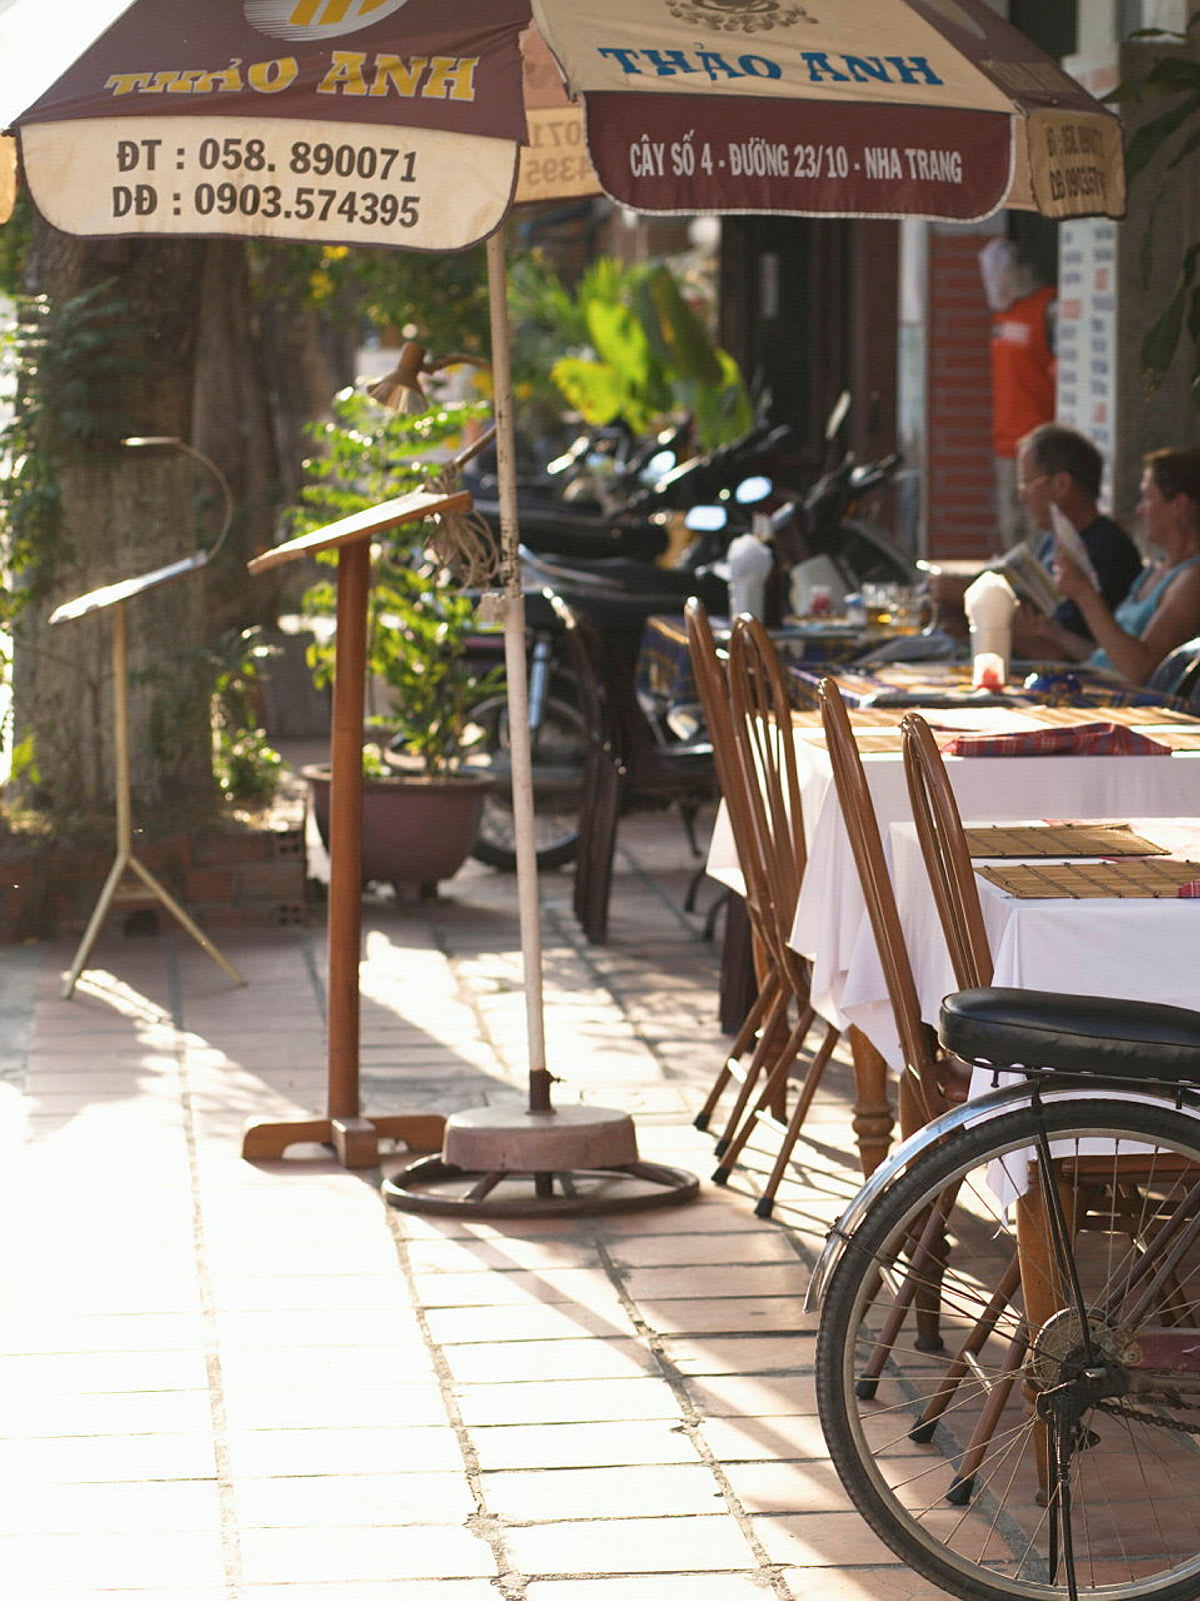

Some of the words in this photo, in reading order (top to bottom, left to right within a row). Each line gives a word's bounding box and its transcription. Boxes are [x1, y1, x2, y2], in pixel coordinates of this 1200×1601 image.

[104, 56, 298, 96] THẢO
[316, 50, 480, 102] ANH
[598, 42, 782, 81] THẢO
[801, 52, 943, 85] ANH
[289, 141, 417, 182] 890071
[629, 133, 665, 177] CÂY
[671, 129, 695, 176] SỐ
[701, 143, 713, 176] 4
[864, 147, 903, 179] NHA
[905, 148, 962, 184] TRANG
[194, 183, 420, 228] 0903.574395
